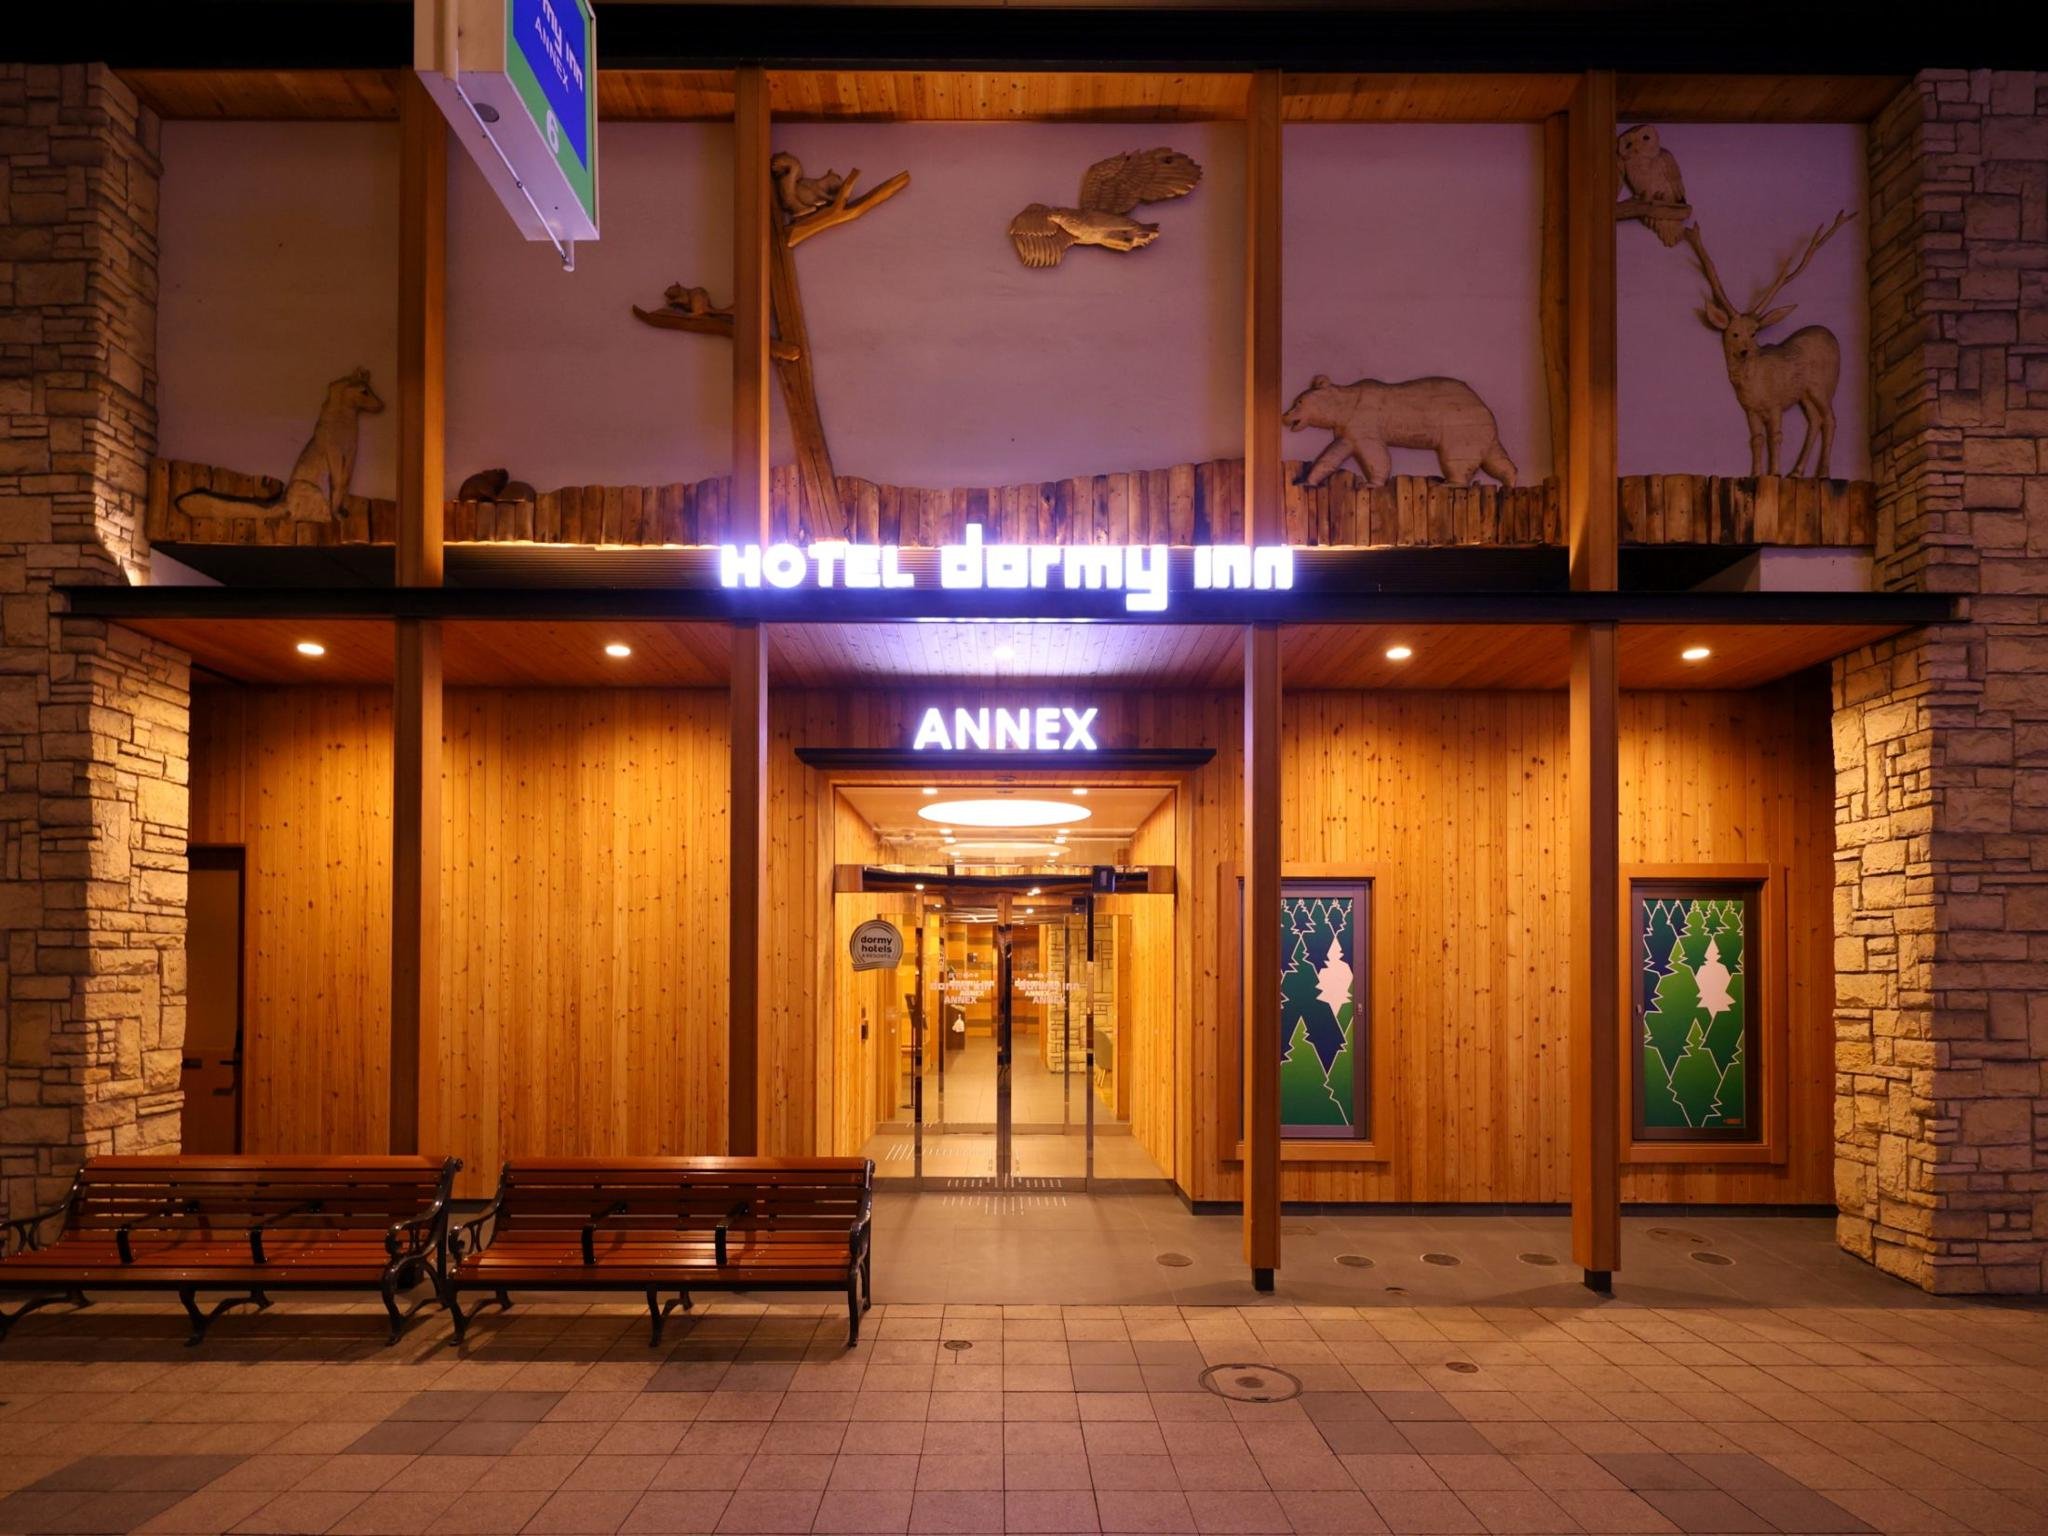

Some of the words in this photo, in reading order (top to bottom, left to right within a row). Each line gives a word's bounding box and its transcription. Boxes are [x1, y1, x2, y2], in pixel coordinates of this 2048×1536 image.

[541, 0, 563, 60] my
[535, 15, 569, 94] ANNEX
[546, 109, 560, 154] 6
[720, 542, 915, 588] HOTEL
[941, 523, 1168, 612] dormy
[1194, 545, 1294, 589] inn
[913, 707, 1098, 750] ANNEX
[860, 935, 892, 945] dormy
[861, 945, 892, 953] hotels
